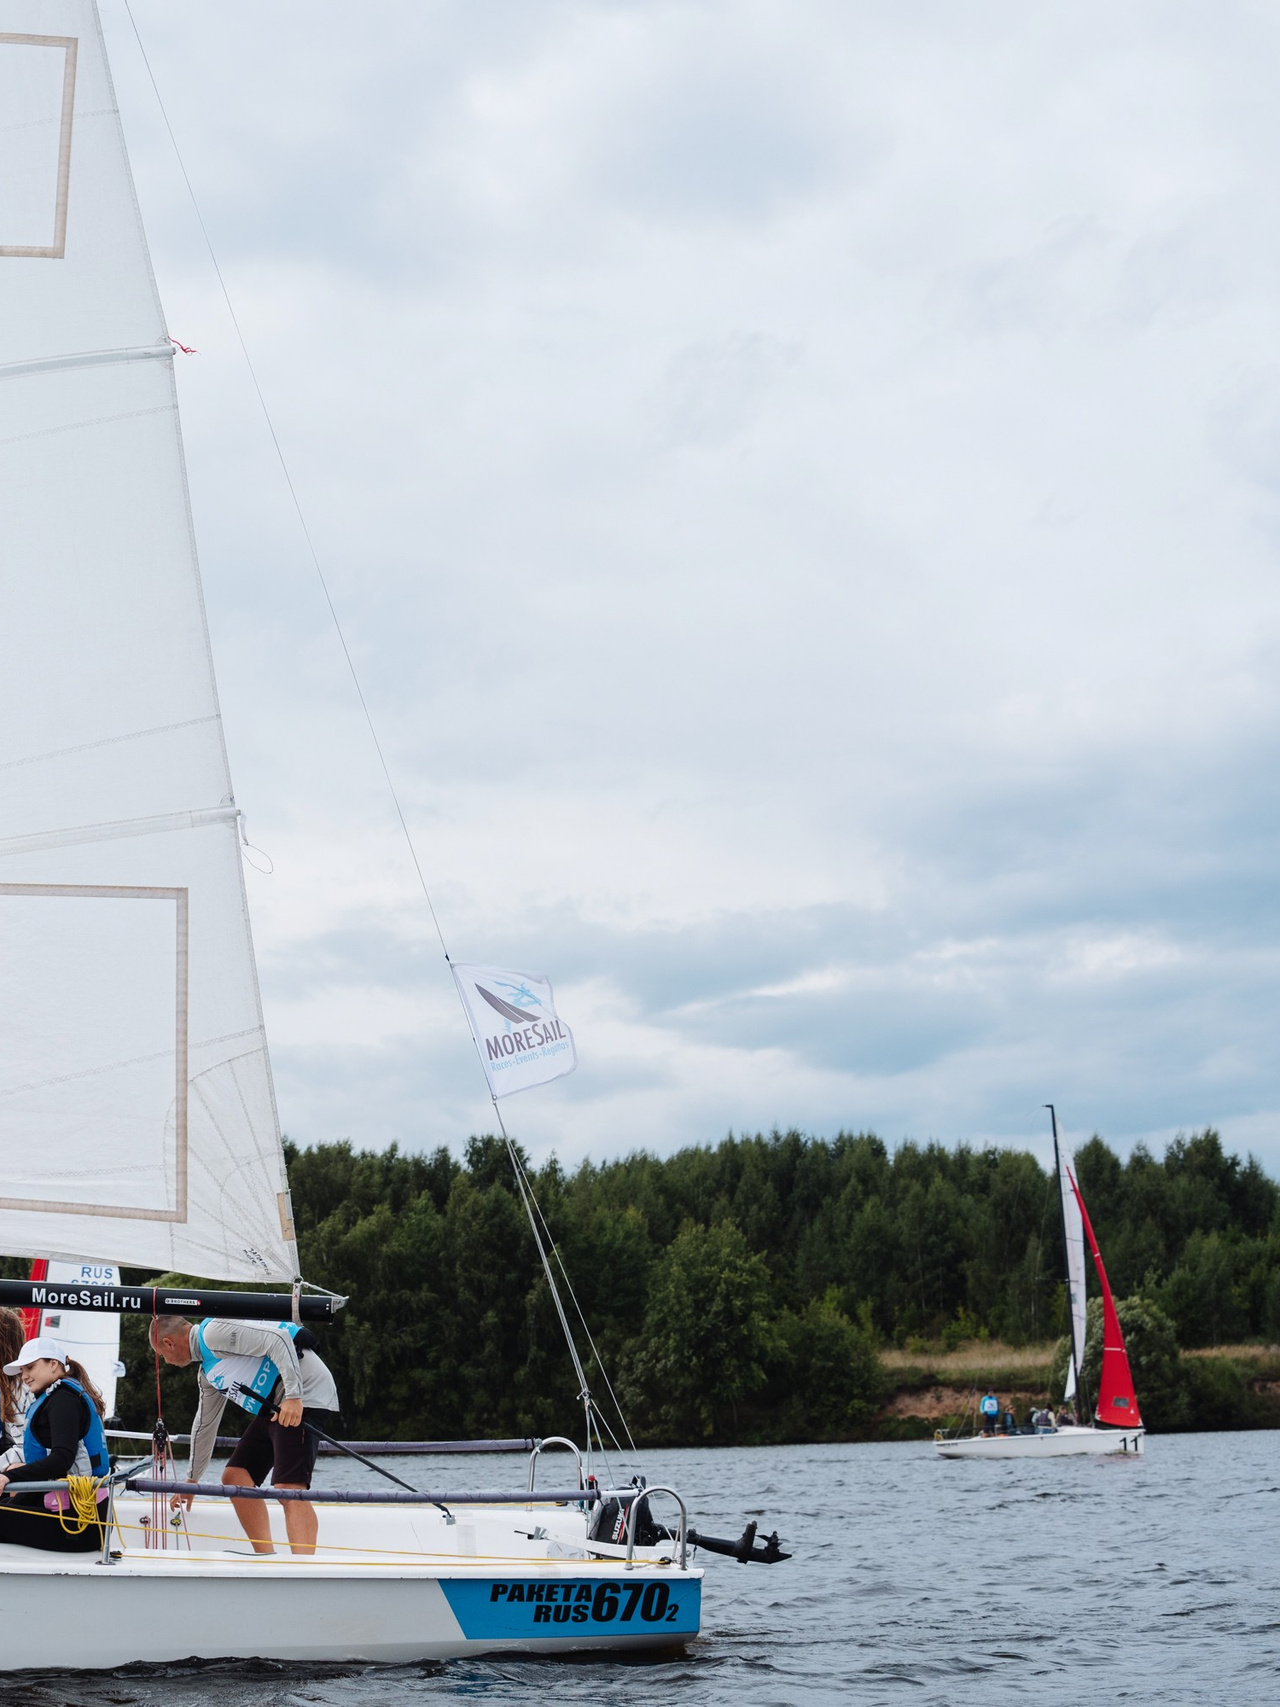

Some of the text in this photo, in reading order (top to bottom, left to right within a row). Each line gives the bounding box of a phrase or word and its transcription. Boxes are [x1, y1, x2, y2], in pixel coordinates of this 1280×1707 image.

[485, 1019, 567, 1061] MORESAIL
[81, 1266, 113, 1279] RUS
[31, 1287, 142, 1309] MoreSail.ru
[1119, 1436, 1138, 1452] 11
[533, 1604, 591, 1623] RUS
